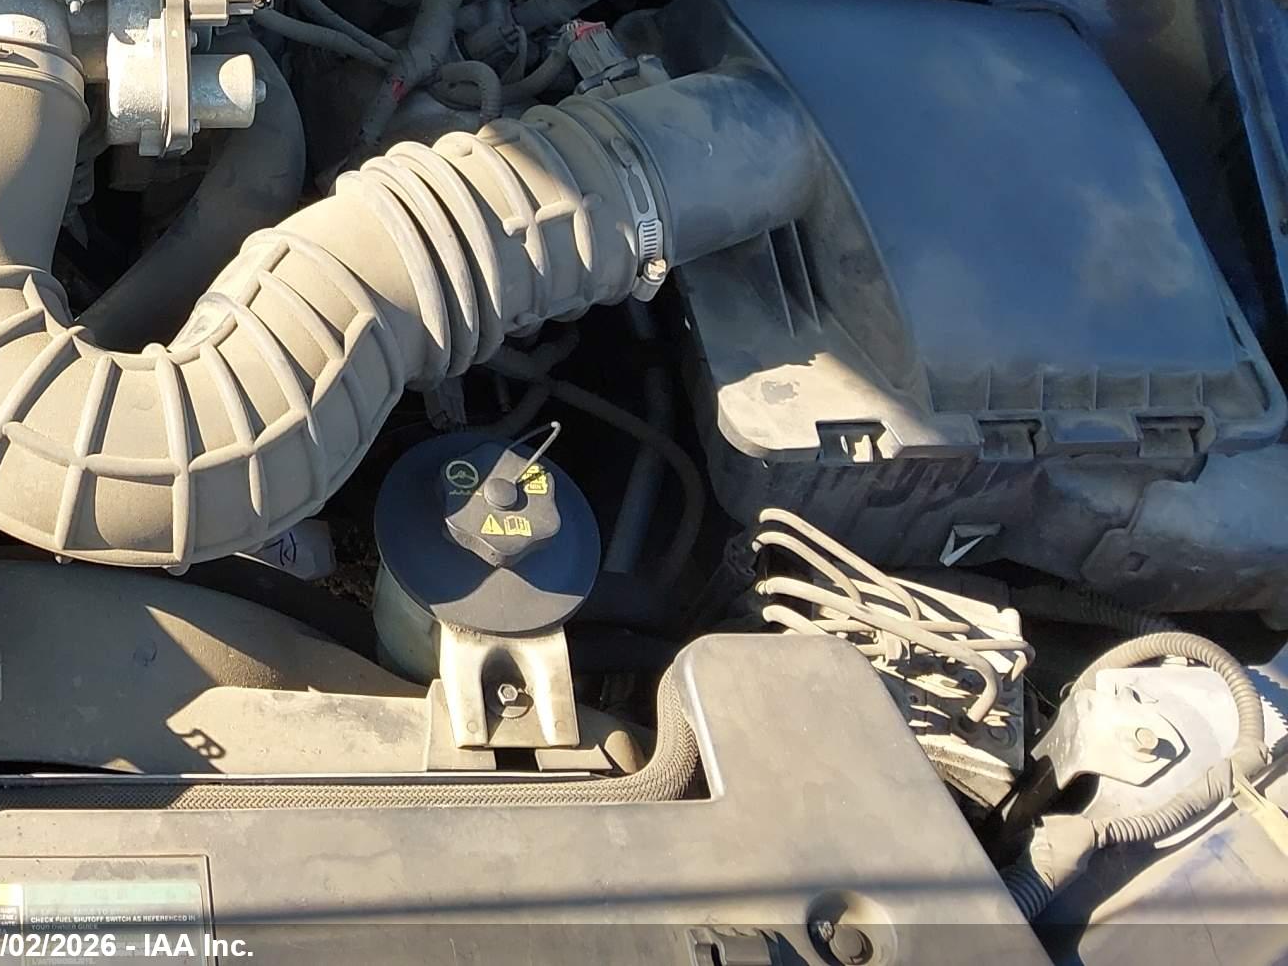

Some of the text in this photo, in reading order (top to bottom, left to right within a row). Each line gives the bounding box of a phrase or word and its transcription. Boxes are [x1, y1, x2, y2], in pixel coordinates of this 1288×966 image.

[30, 916, 54, 924] CHECK
[73, 915, 104, 923] SHUTOFF
[105, 915, 131, 923] SWITCH
